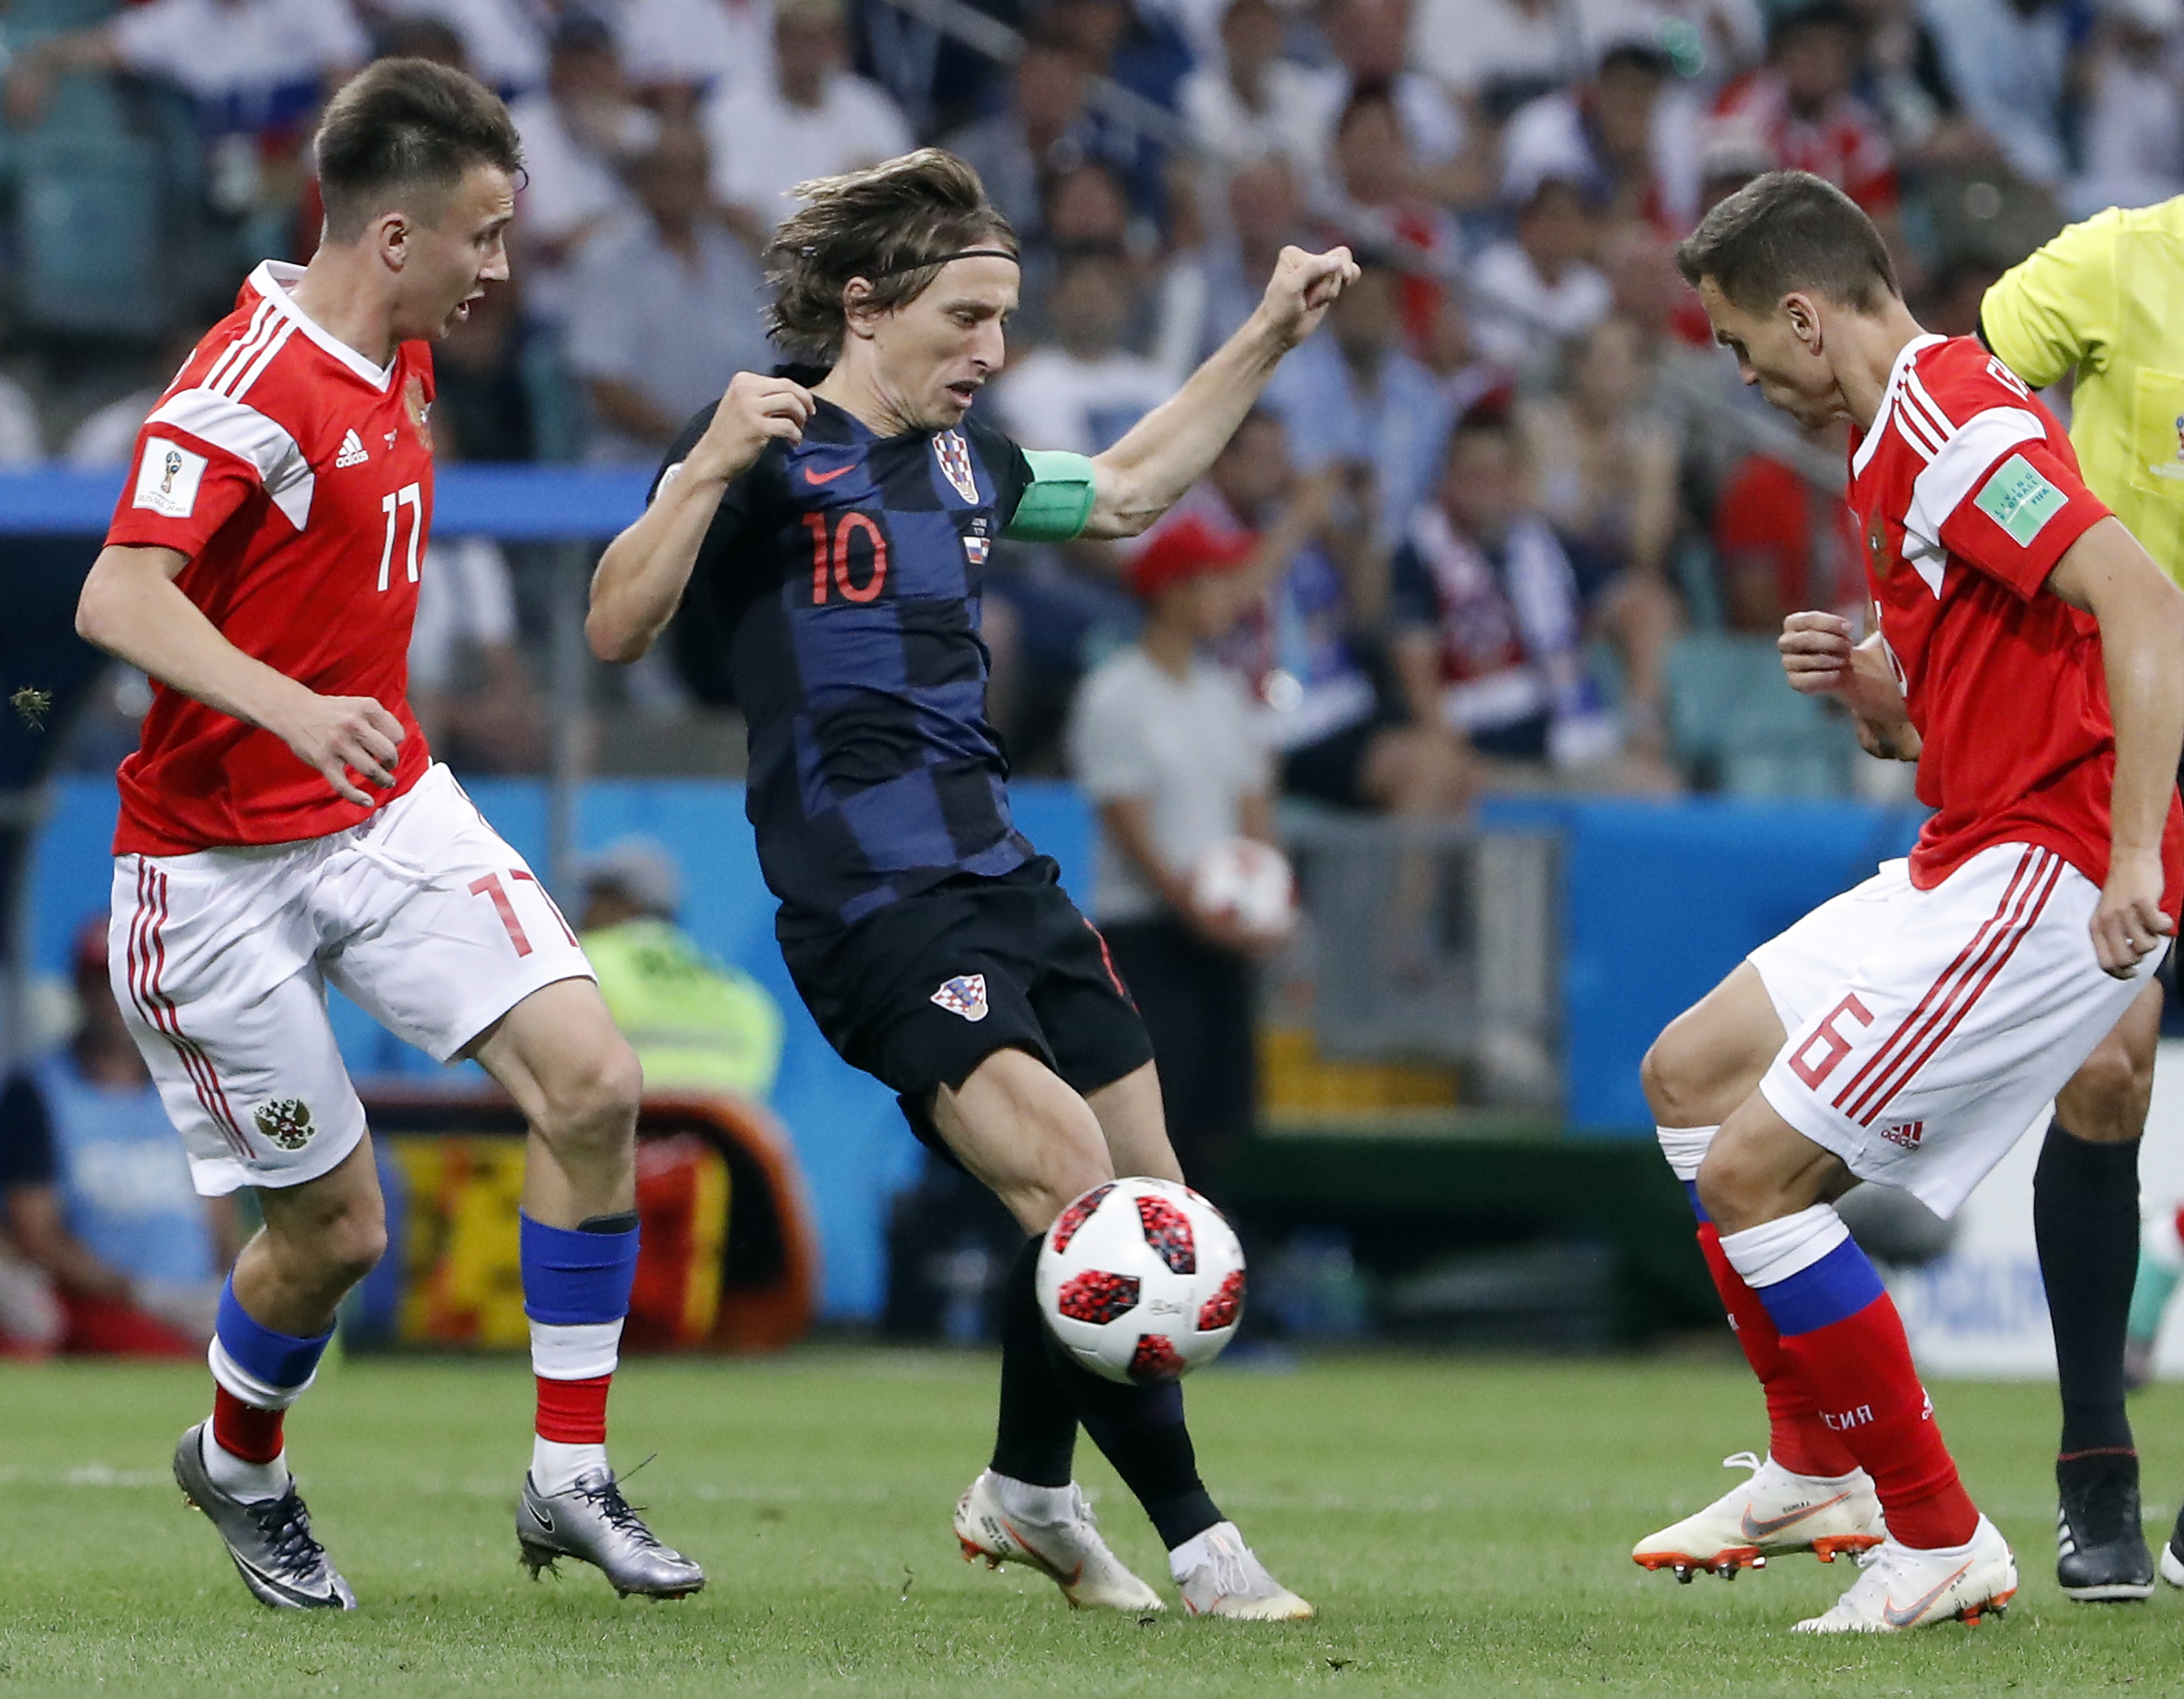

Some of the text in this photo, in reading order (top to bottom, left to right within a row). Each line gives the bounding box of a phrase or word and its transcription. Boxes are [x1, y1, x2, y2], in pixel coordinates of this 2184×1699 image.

[335, 450, 369, 468] adidas
[1994, 473, 2033, 515] LIVING
[2031, 488, 2049, 505] FIFA
[377, 482, 422, 592] 17
[801, 512, 888, 604] 10
[1788, 992, 1874, 1091] 6
[1881, 1130, 1921, 1150] adidas
[1819, 1404, 1873, 1431] СИЯ
